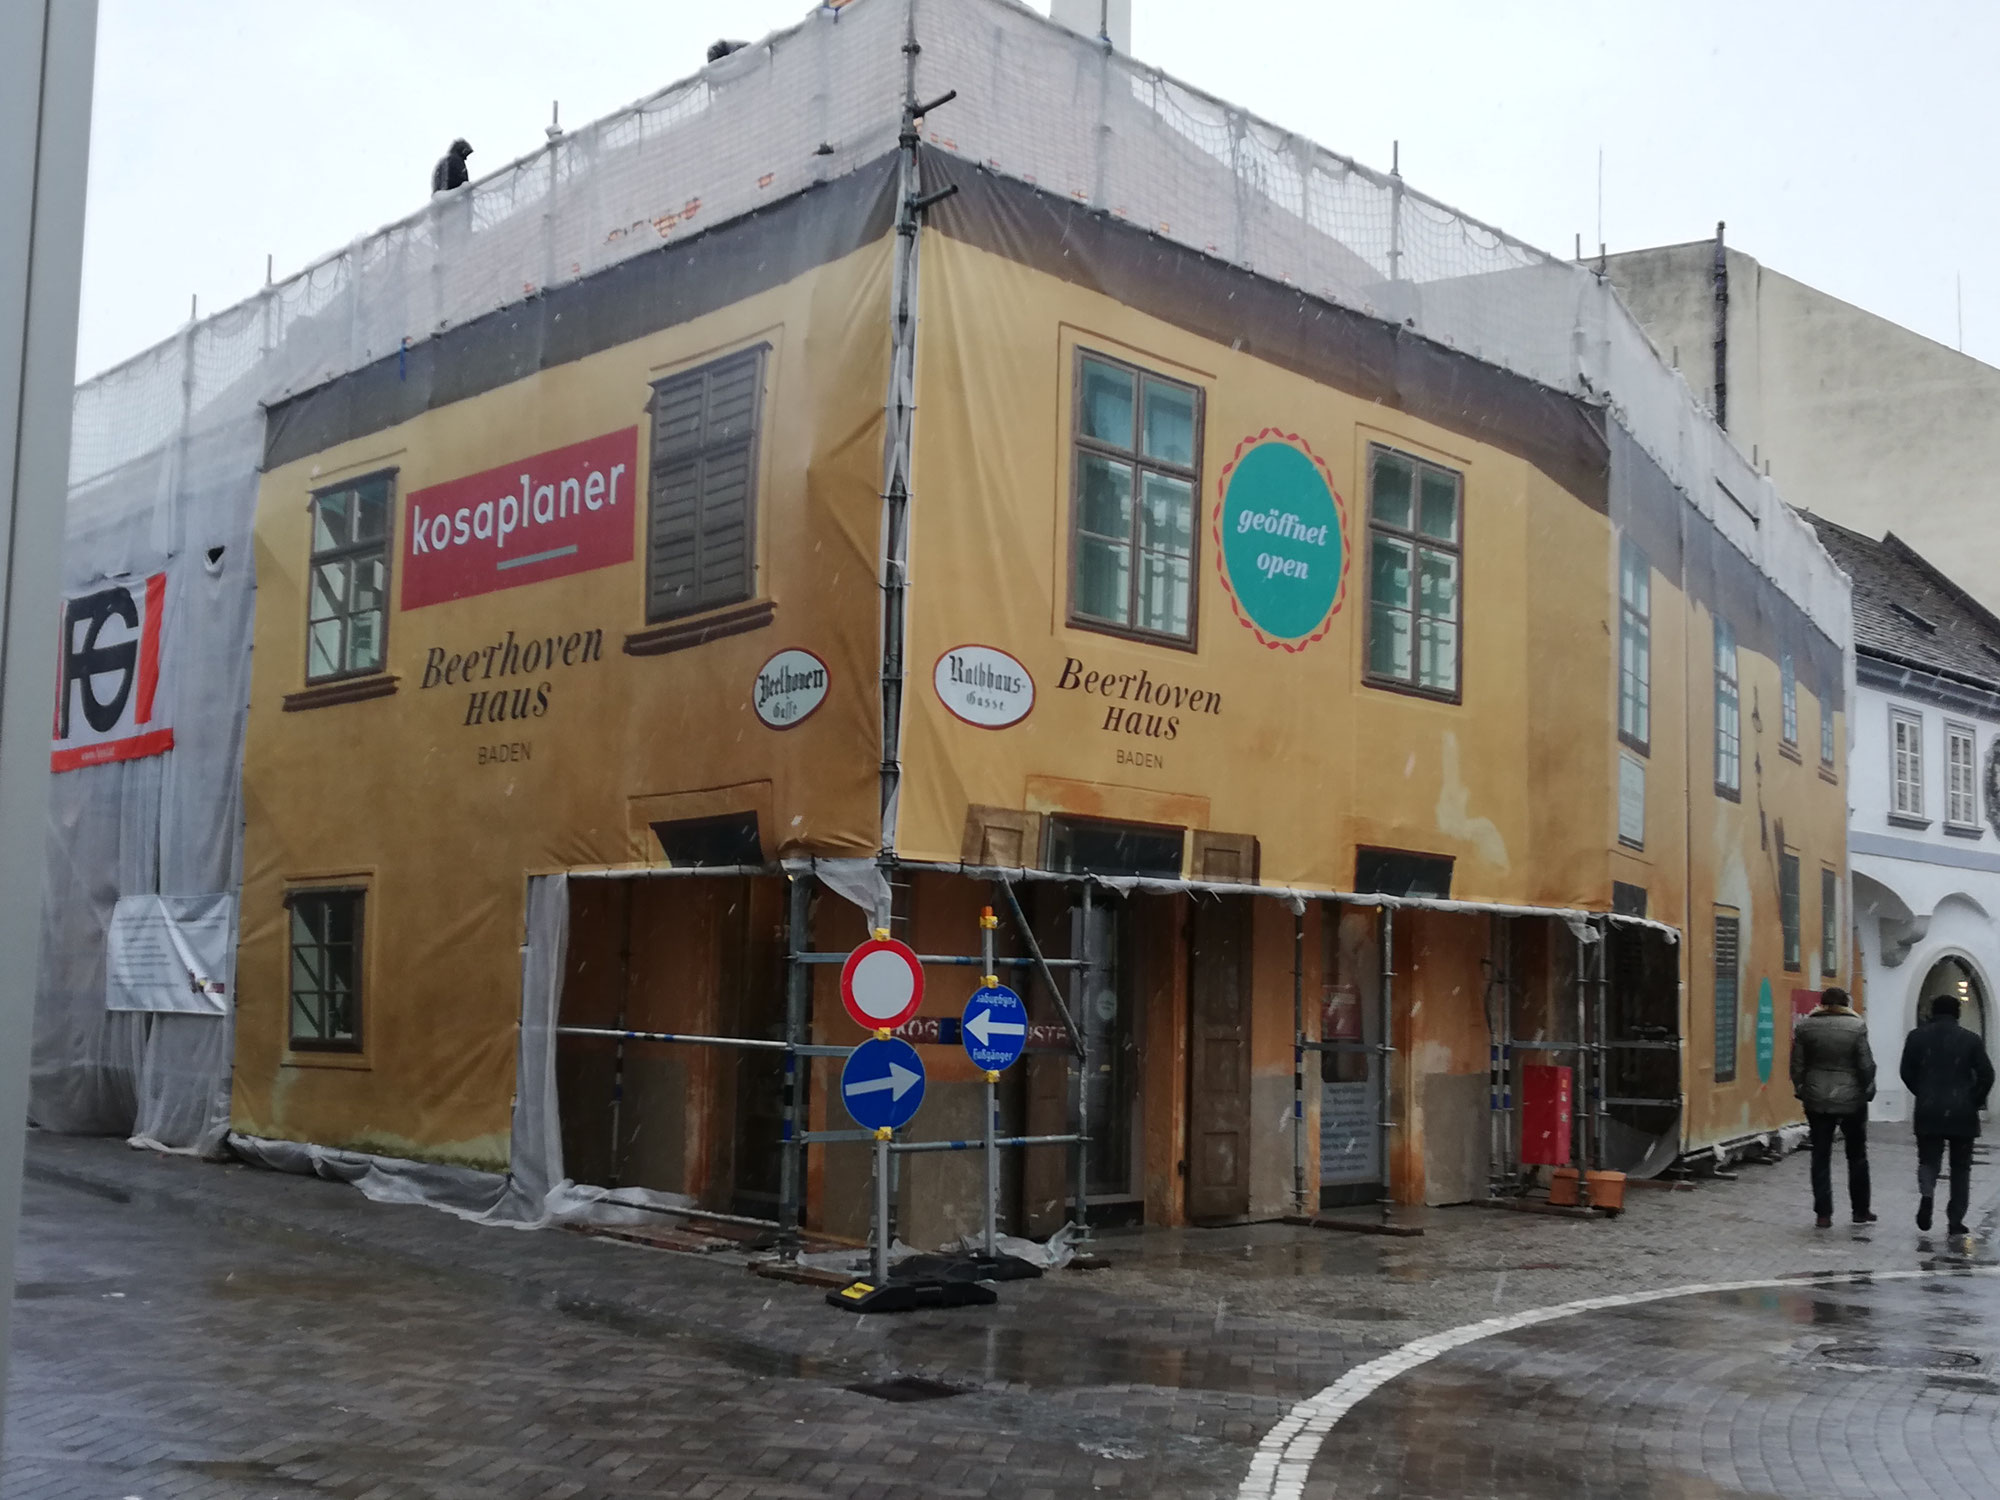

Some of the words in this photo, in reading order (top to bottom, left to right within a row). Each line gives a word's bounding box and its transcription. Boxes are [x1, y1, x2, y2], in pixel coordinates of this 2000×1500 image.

[413, 463, 625, 555] kosaplaner
[1237, 508, 1328, 546] geöffnet
[1256, 552, 1309, 579] open
[463, 681, 553, 726] Haus
[1101, 705, 1180, 740] Haus
[478, 742, 534, 766] BADEN
[1116, 749, 1163, 769] BADEN
[972, 1047, 1014, 1063] Fußgänger
